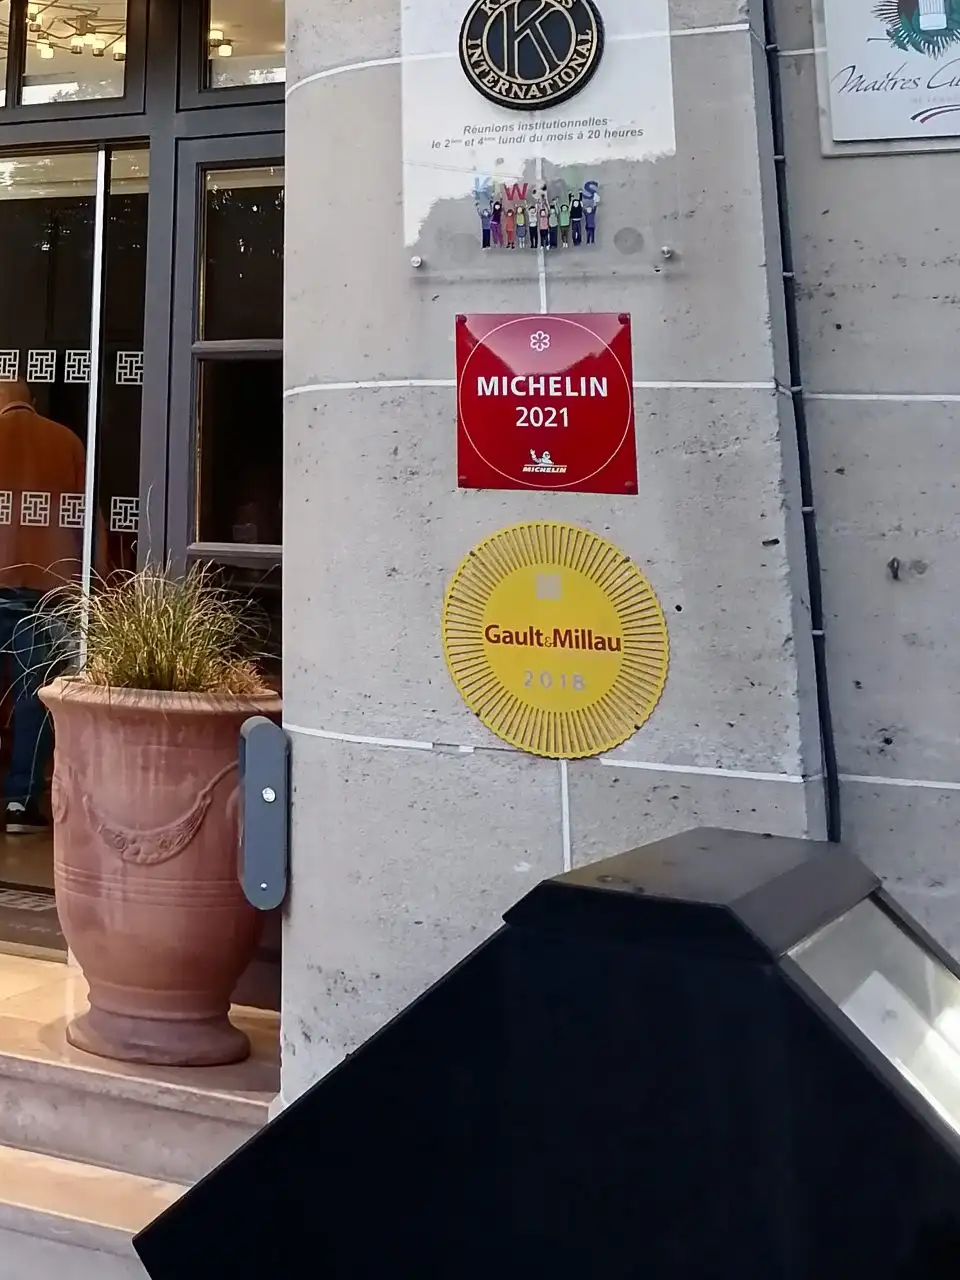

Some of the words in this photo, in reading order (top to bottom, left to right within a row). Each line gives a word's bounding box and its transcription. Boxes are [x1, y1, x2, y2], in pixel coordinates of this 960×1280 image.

[468, 29, 592, 99] INTERNATIONAL
[518, 116, 608, 132] institutionnelles
[431, 139, 441, 149] le
[464, 138, 474, 147] et
[498, 133, 526, 145] lundi
[529, 133, 543, 143] du
[546, 131, 574, 142] mois
[587, 129, 601, 139] 20
[604, 127, 644, 139] heures
[477, 376, 608, 397] MICHELIN
[515, 406, 569, 428] 2021
[484, 624, 622, 652] Gault&Millau
[523, 670, 587, 692] 2018
